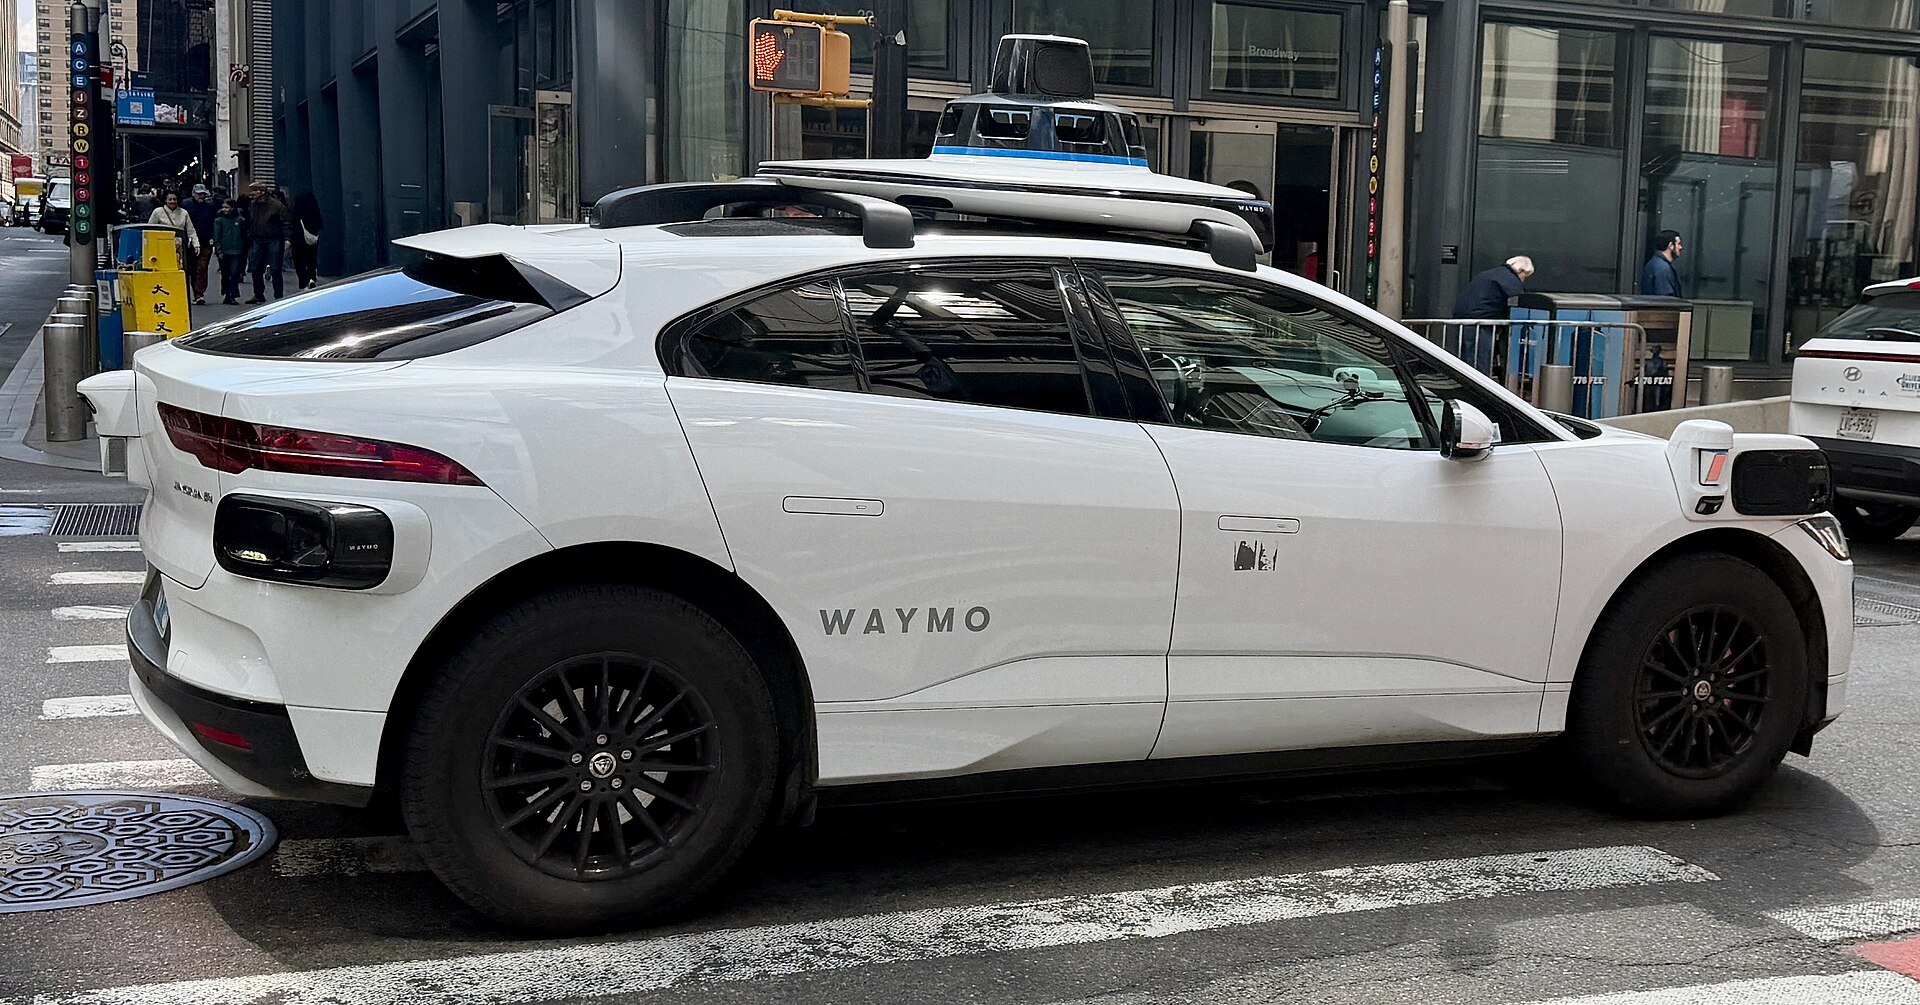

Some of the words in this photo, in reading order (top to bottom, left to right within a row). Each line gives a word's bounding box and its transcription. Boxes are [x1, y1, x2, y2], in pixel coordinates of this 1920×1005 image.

[75, 44, 83, 53] A
[1248, 45, 1300, 61] Broadway
[75, 60, 84, 70] C
[76, 76, 84, 86] E
[77, 109, 84, 118] Z
[77, 125, 86, 135] R
[76, 142, 87, 151] W
[1238, 205, 1265, 213] WAYMO
[1634, 376, 1653, 385] 176
[1821, 386, 1888, 397] KONA
[349, 543, 379, 551] WAYMO
[819, 606, 991, 636] WAYMO
